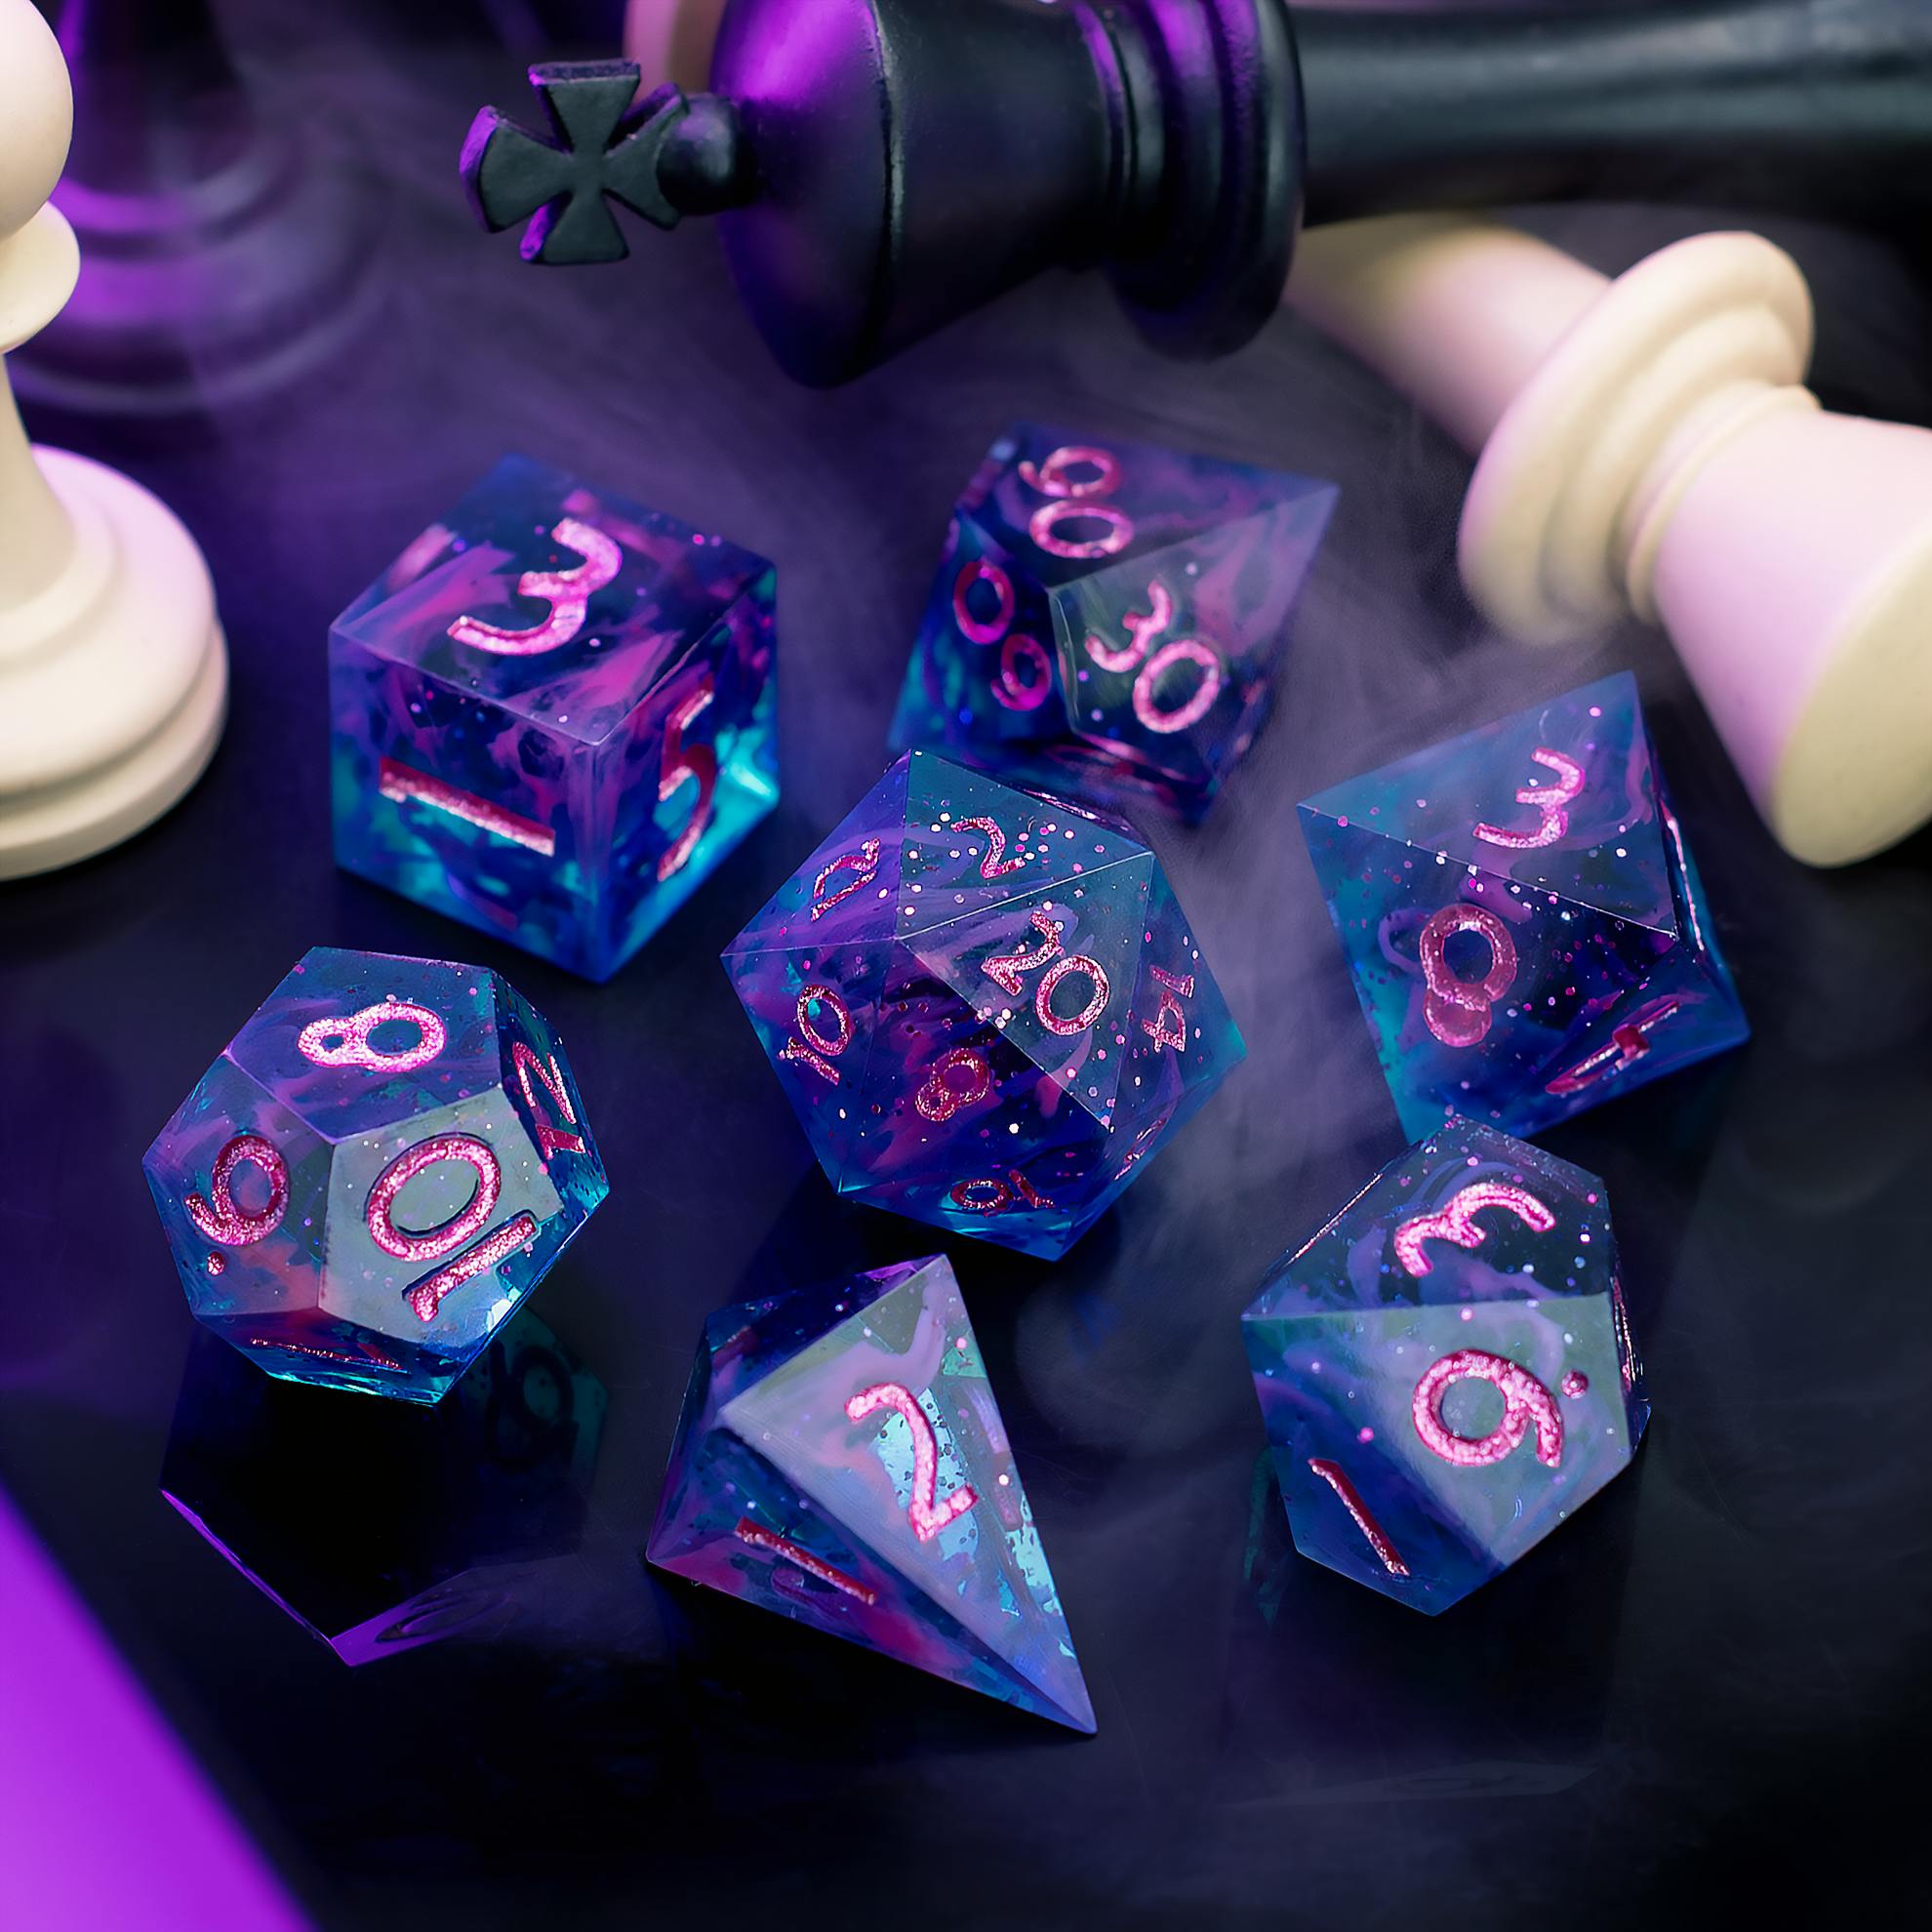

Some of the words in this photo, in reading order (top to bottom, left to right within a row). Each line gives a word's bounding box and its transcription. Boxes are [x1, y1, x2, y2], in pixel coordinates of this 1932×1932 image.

[446, 517, 623, 656] 3
[1085, 580, 1221, 733] 30
[657, 672, 716, 882] 5
[1471, 746, 1586, 849] 3
[949, 816, 1027, 879] 2
[780, 983, 853, 1085] 10
[981, 912, 1110, 1036] 20
[1419, 903, 1518, 1048] 8
[298, 1001, 447, 1073] 8
[915, 1047, 990, 1122] 8
[365, 1130, 539, 1323] 10
[1394, 1182, 1557, 1277] 3
[844, 1382, 980, 1542] 2
